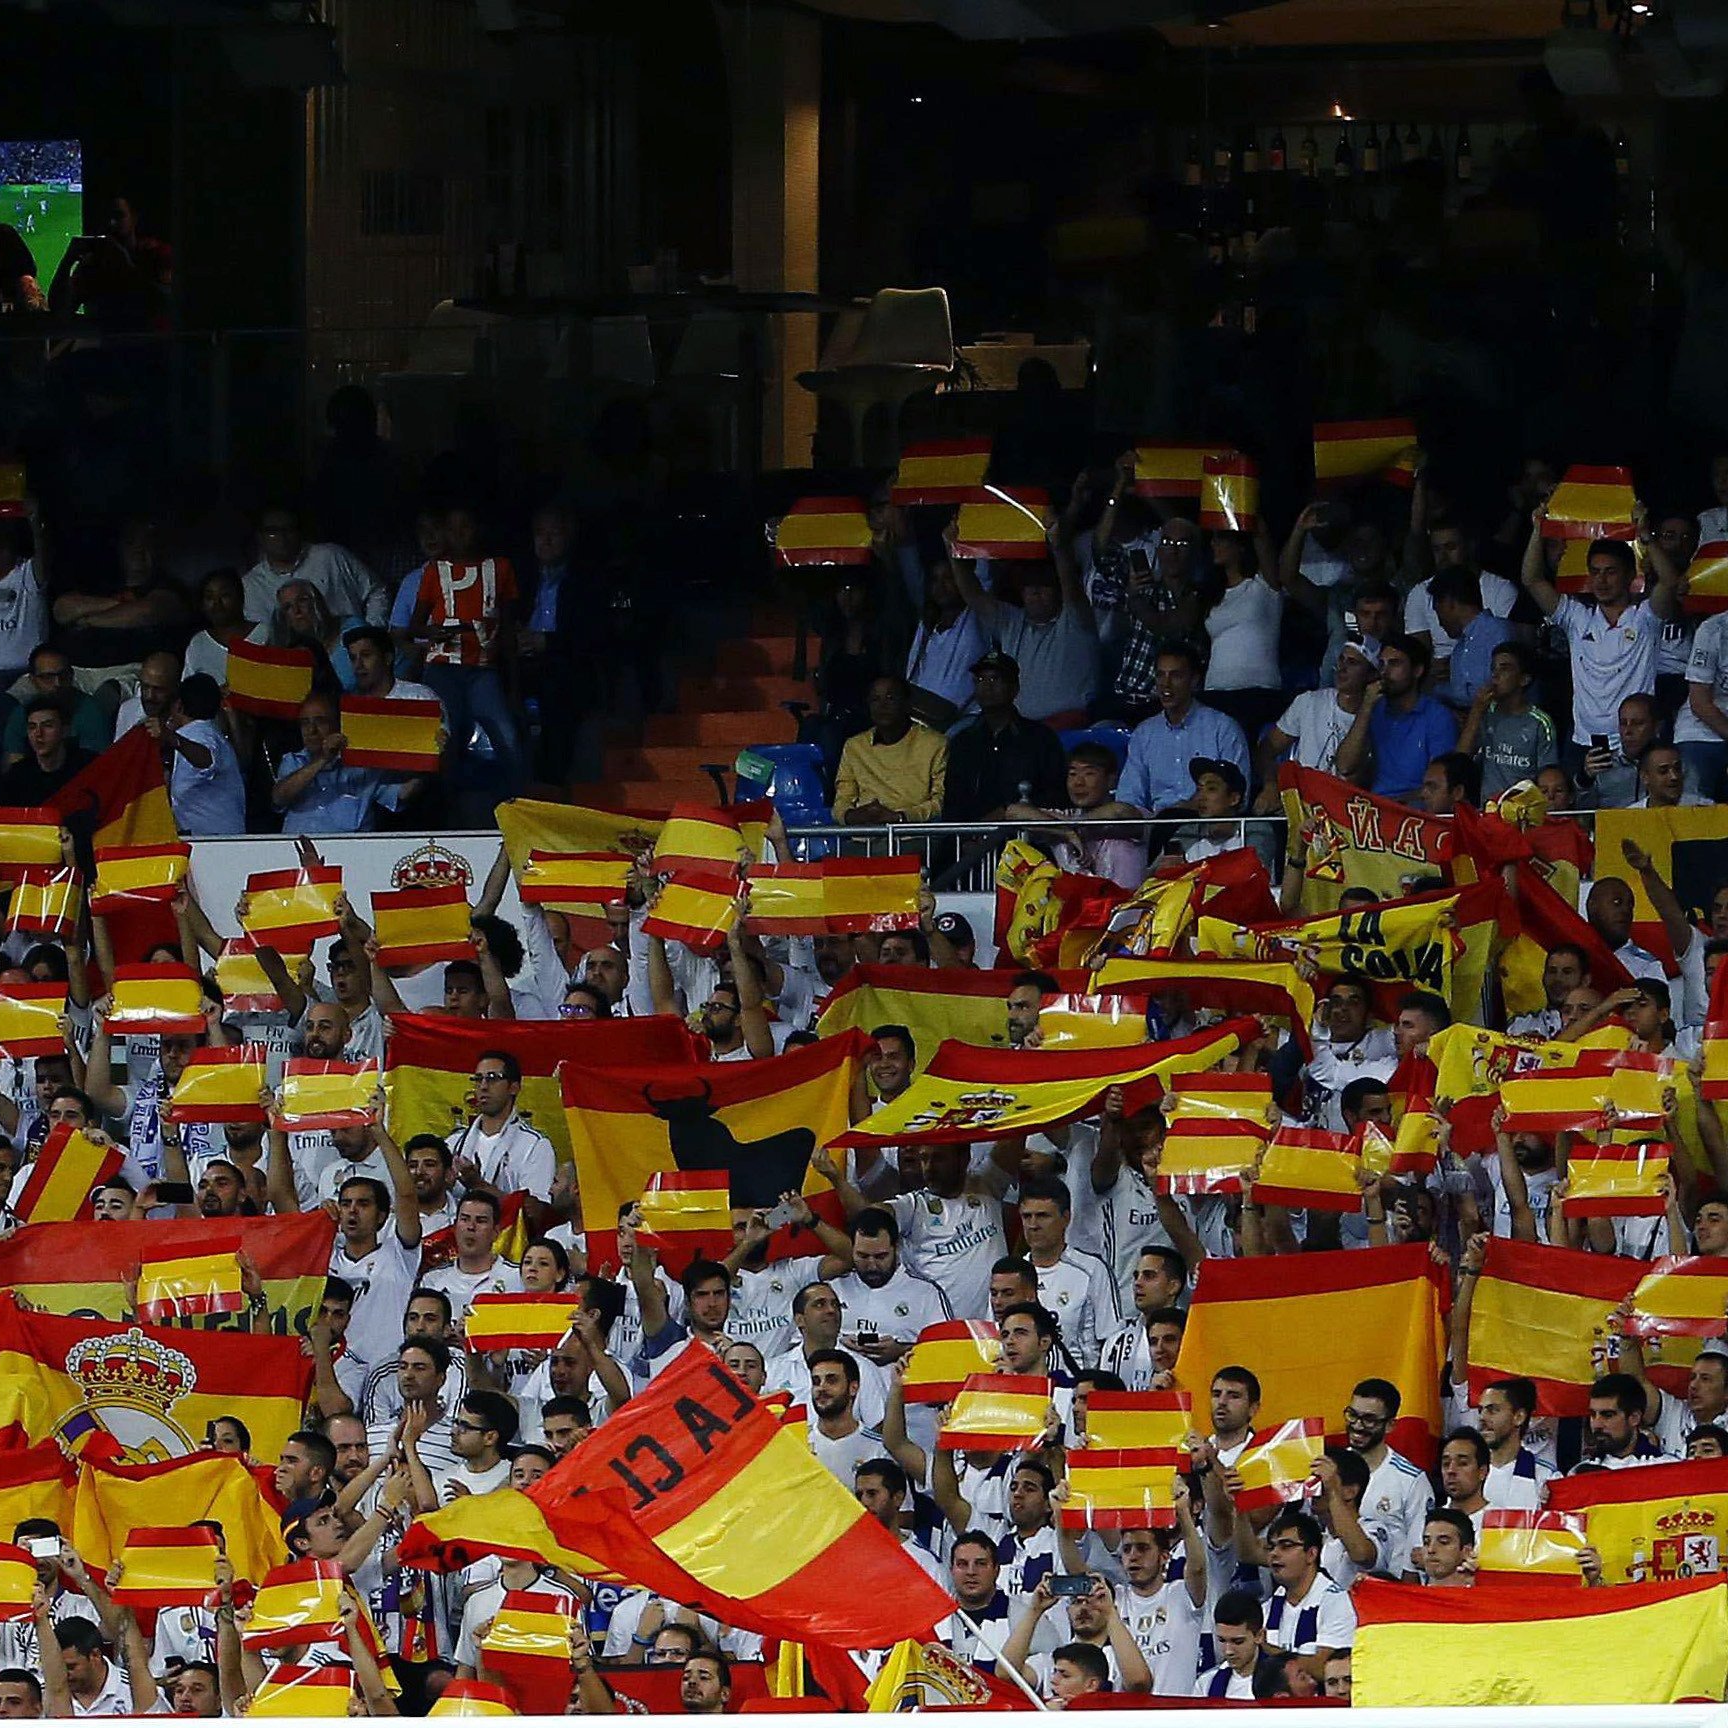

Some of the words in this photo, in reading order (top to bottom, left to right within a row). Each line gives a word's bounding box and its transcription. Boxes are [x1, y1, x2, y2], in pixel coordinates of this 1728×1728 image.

[955, 1220, 973, 1236] Fly
[934, 1224, 998, 1257] Emirates
[749, 1305, 769, 1319] Fly
[726, 1315, 790, 1337] Emirates
[856, 1319, 878, 1335] Fly
